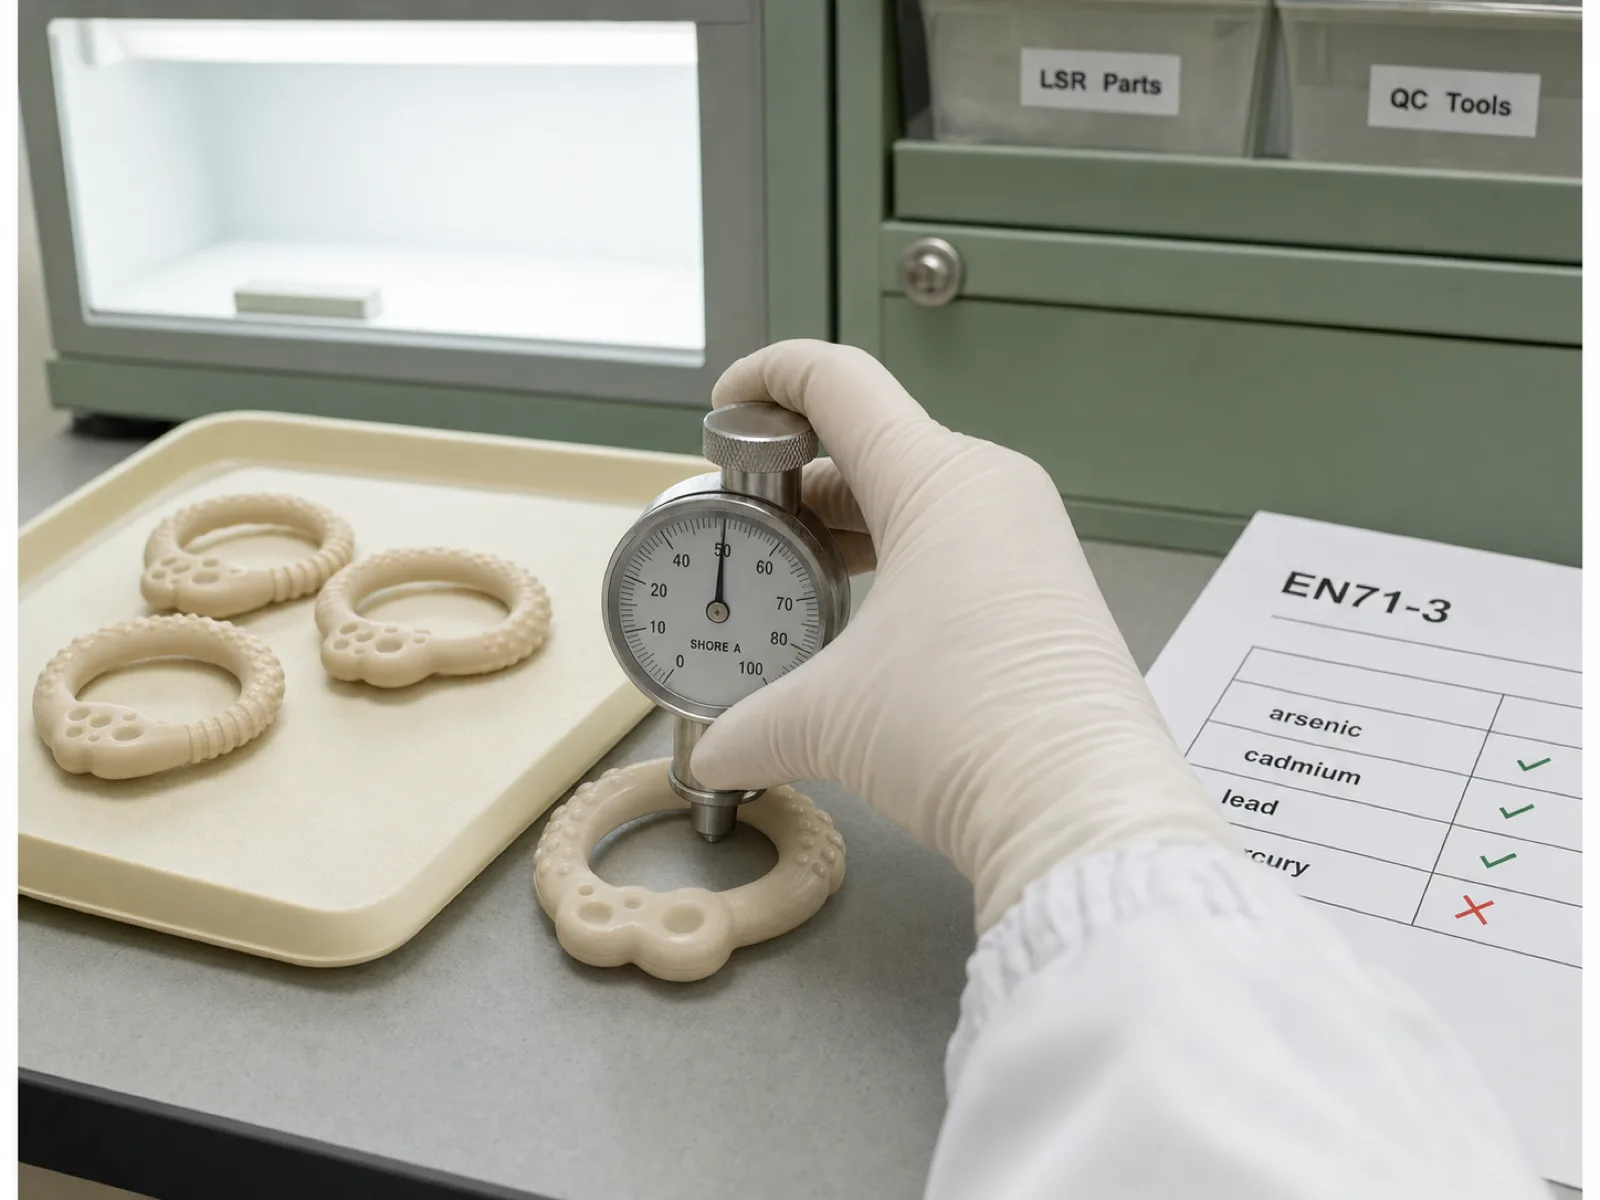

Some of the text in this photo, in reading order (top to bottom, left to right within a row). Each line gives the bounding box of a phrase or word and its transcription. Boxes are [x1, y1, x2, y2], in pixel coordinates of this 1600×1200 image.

[1040, 69, 1162, 96] LSR Parts
[1390, 87, 1512, 117] QC Tools
[714, 542, 732, 558] 50
[672, 553, 691, 568] 40
[756, 559, 774, 576] 60
[650, 582, 668, 598] 20
[1281, 570, 1452, 624] EN71-3
[776, 596, 793, 612] 70
[650, 619, 666, 634] 10
[690, 638, 742, 654] SHORE A
[770, 631, 788, 646] 80
[675, 654, 685, 668] 0
[738, 660, 764, 676] 100
[1269, 706, 1363, 739] arsenic
[1244, 748, 1362, 787] cadmium
[1221, 788, 1280, 816] lead
